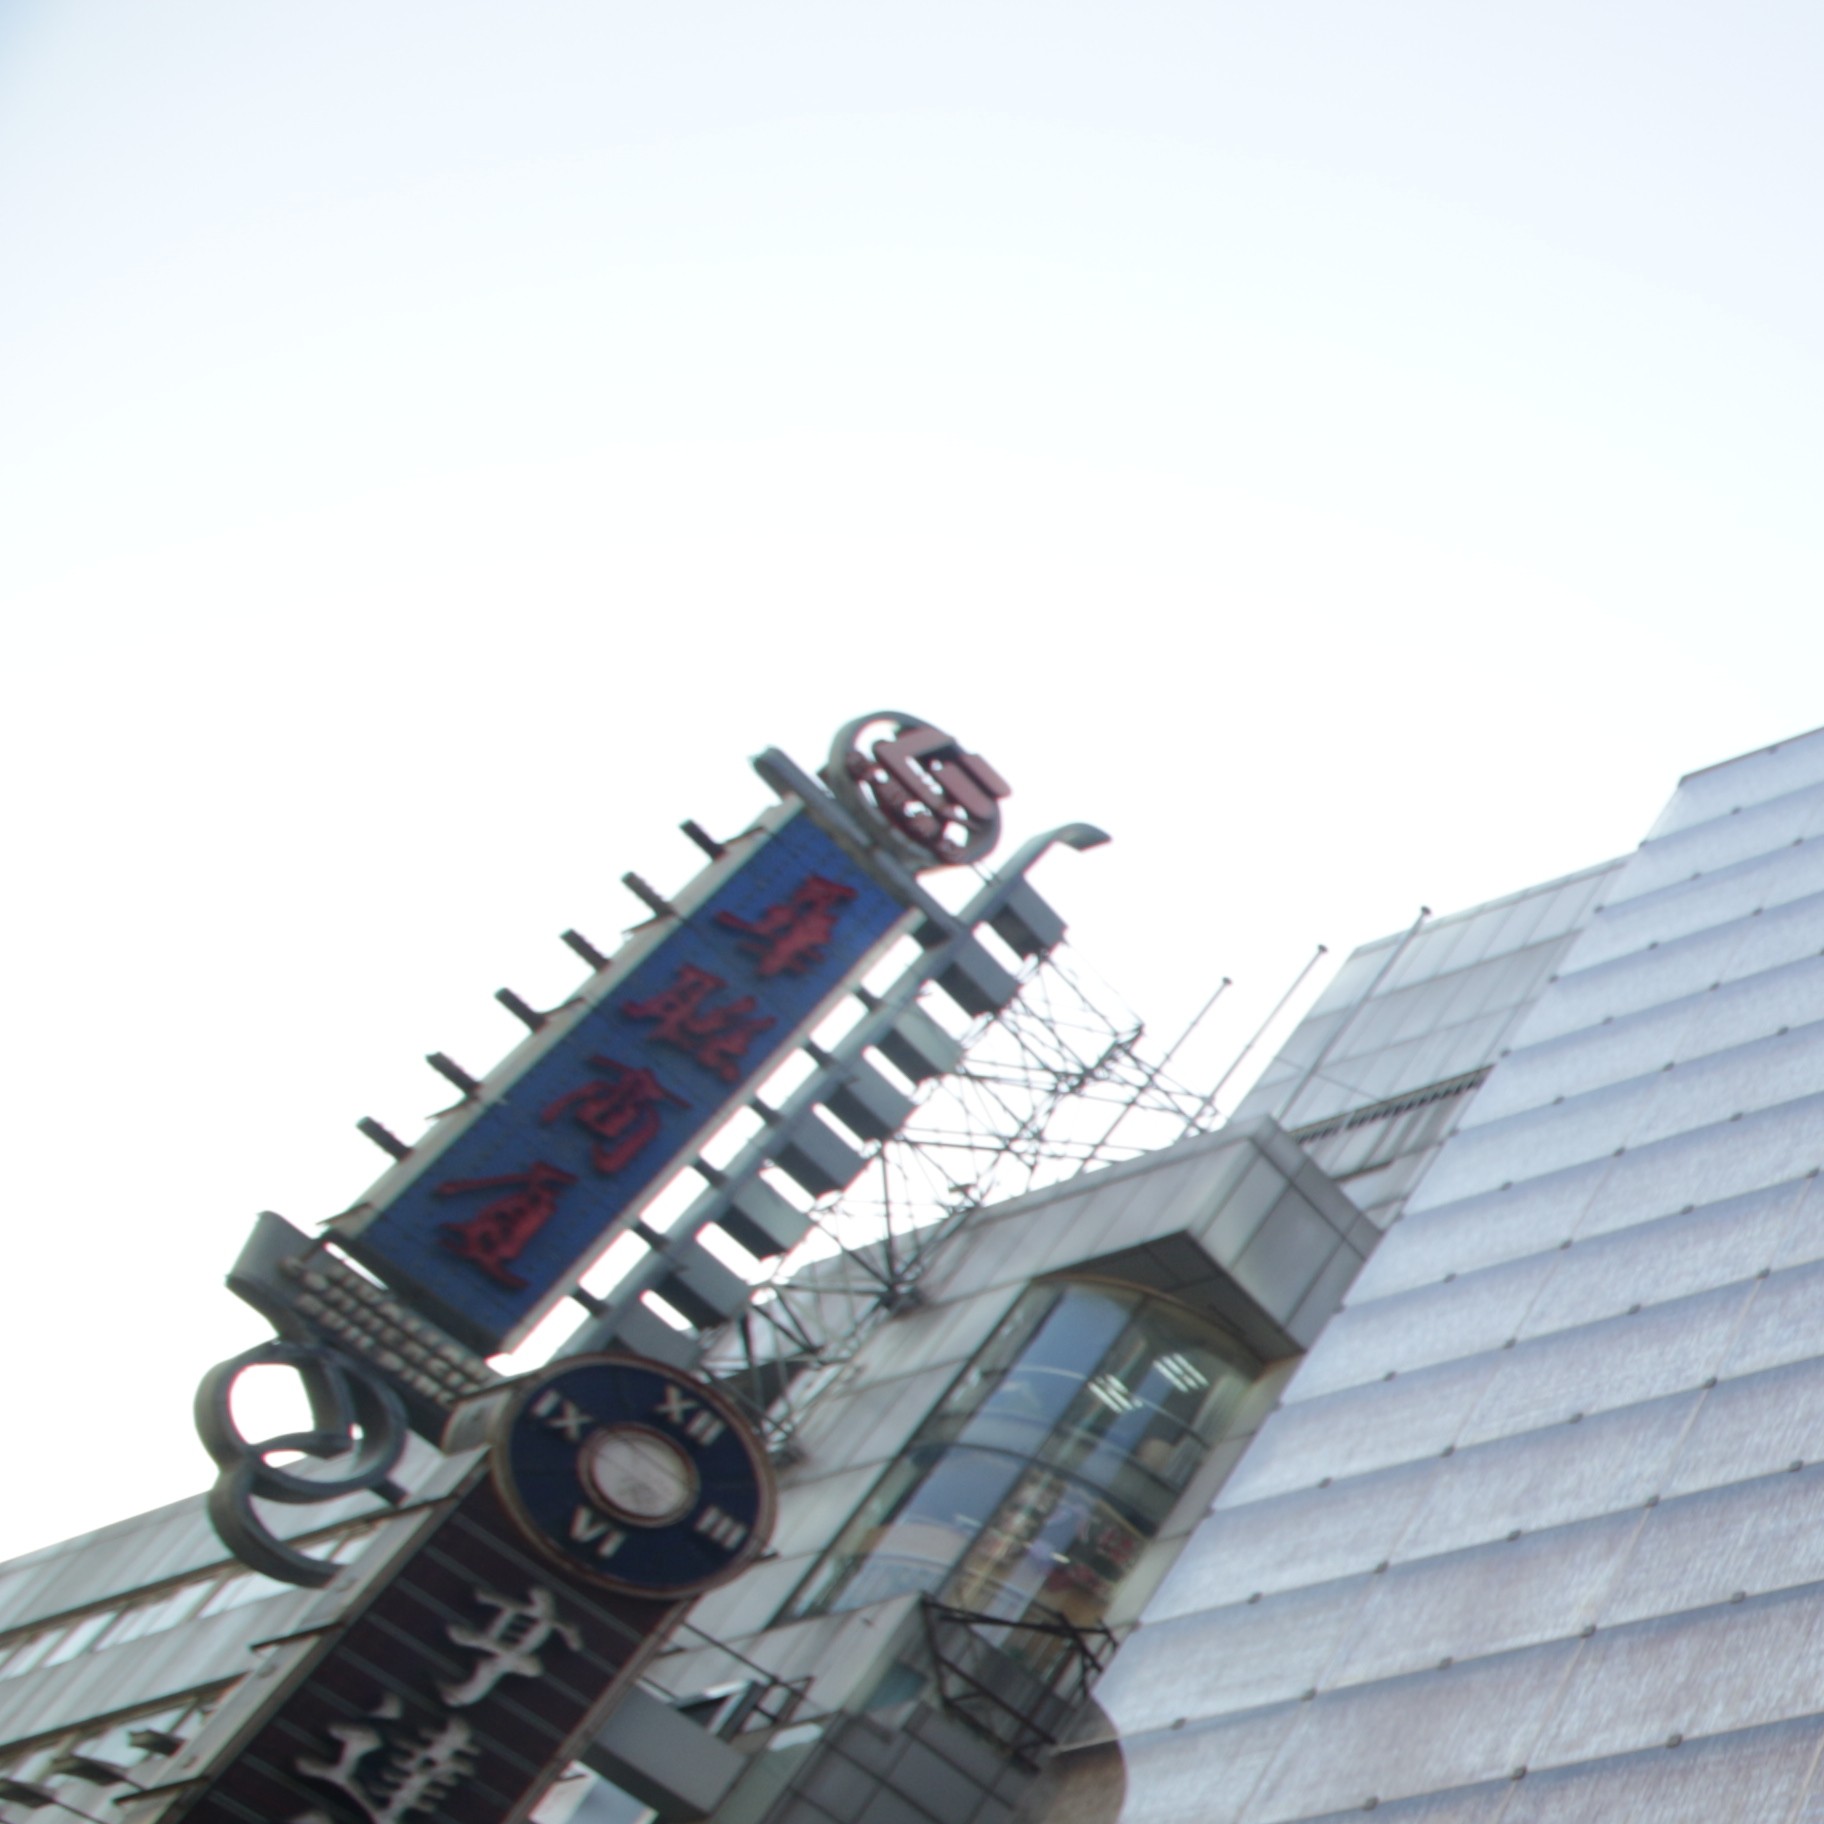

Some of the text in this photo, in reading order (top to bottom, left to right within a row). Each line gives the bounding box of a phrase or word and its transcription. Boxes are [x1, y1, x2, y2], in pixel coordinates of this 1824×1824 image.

[530, 1388, 594, 1441] IX
[655, 1385, 726, 1446] XII
[570, 1503, 627, 1559] VI
[696, 1504, 747, 1550] III
